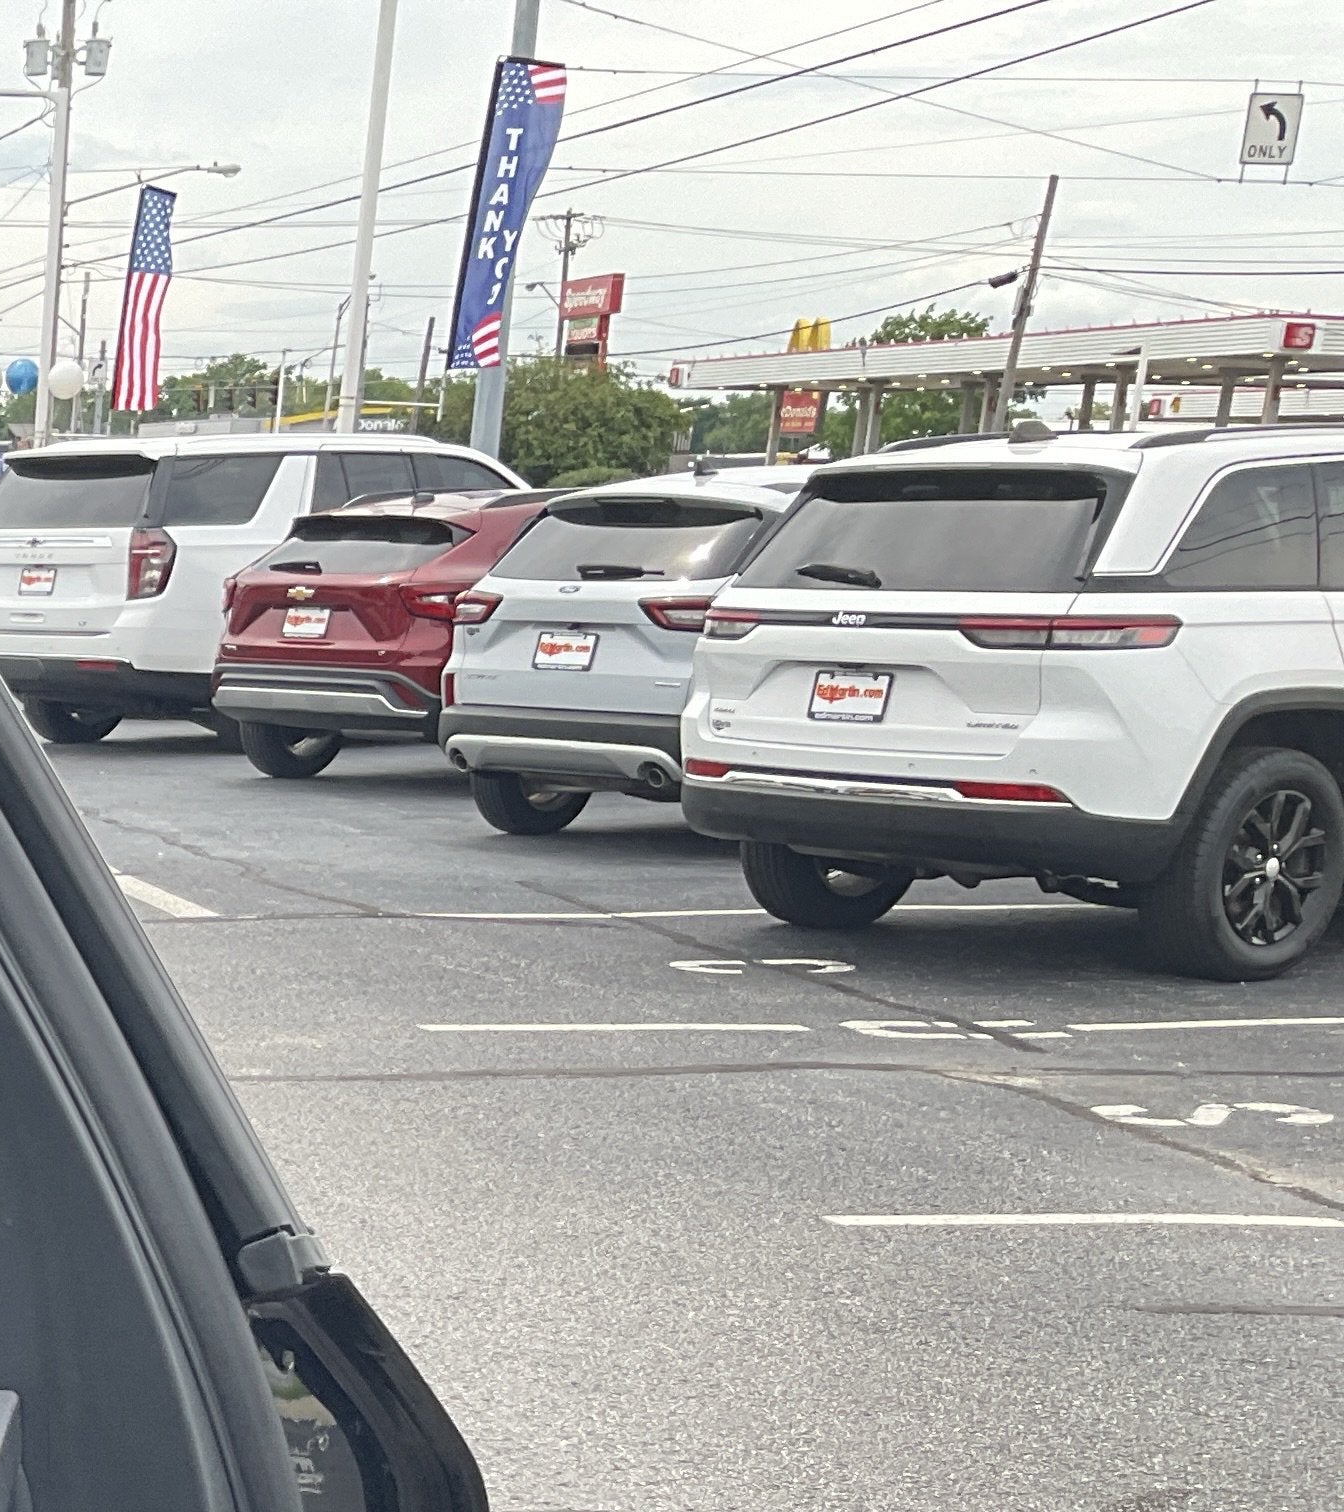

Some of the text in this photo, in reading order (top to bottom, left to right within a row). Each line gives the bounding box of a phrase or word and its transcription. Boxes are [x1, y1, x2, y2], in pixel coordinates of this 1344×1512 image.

[1248, 145, 1287, 158] ONLY
[477, 128, 523, 259] THANK
[832, 611, 866, 627] Jeep
[817, 684, 883, 699] EdMartin.com
